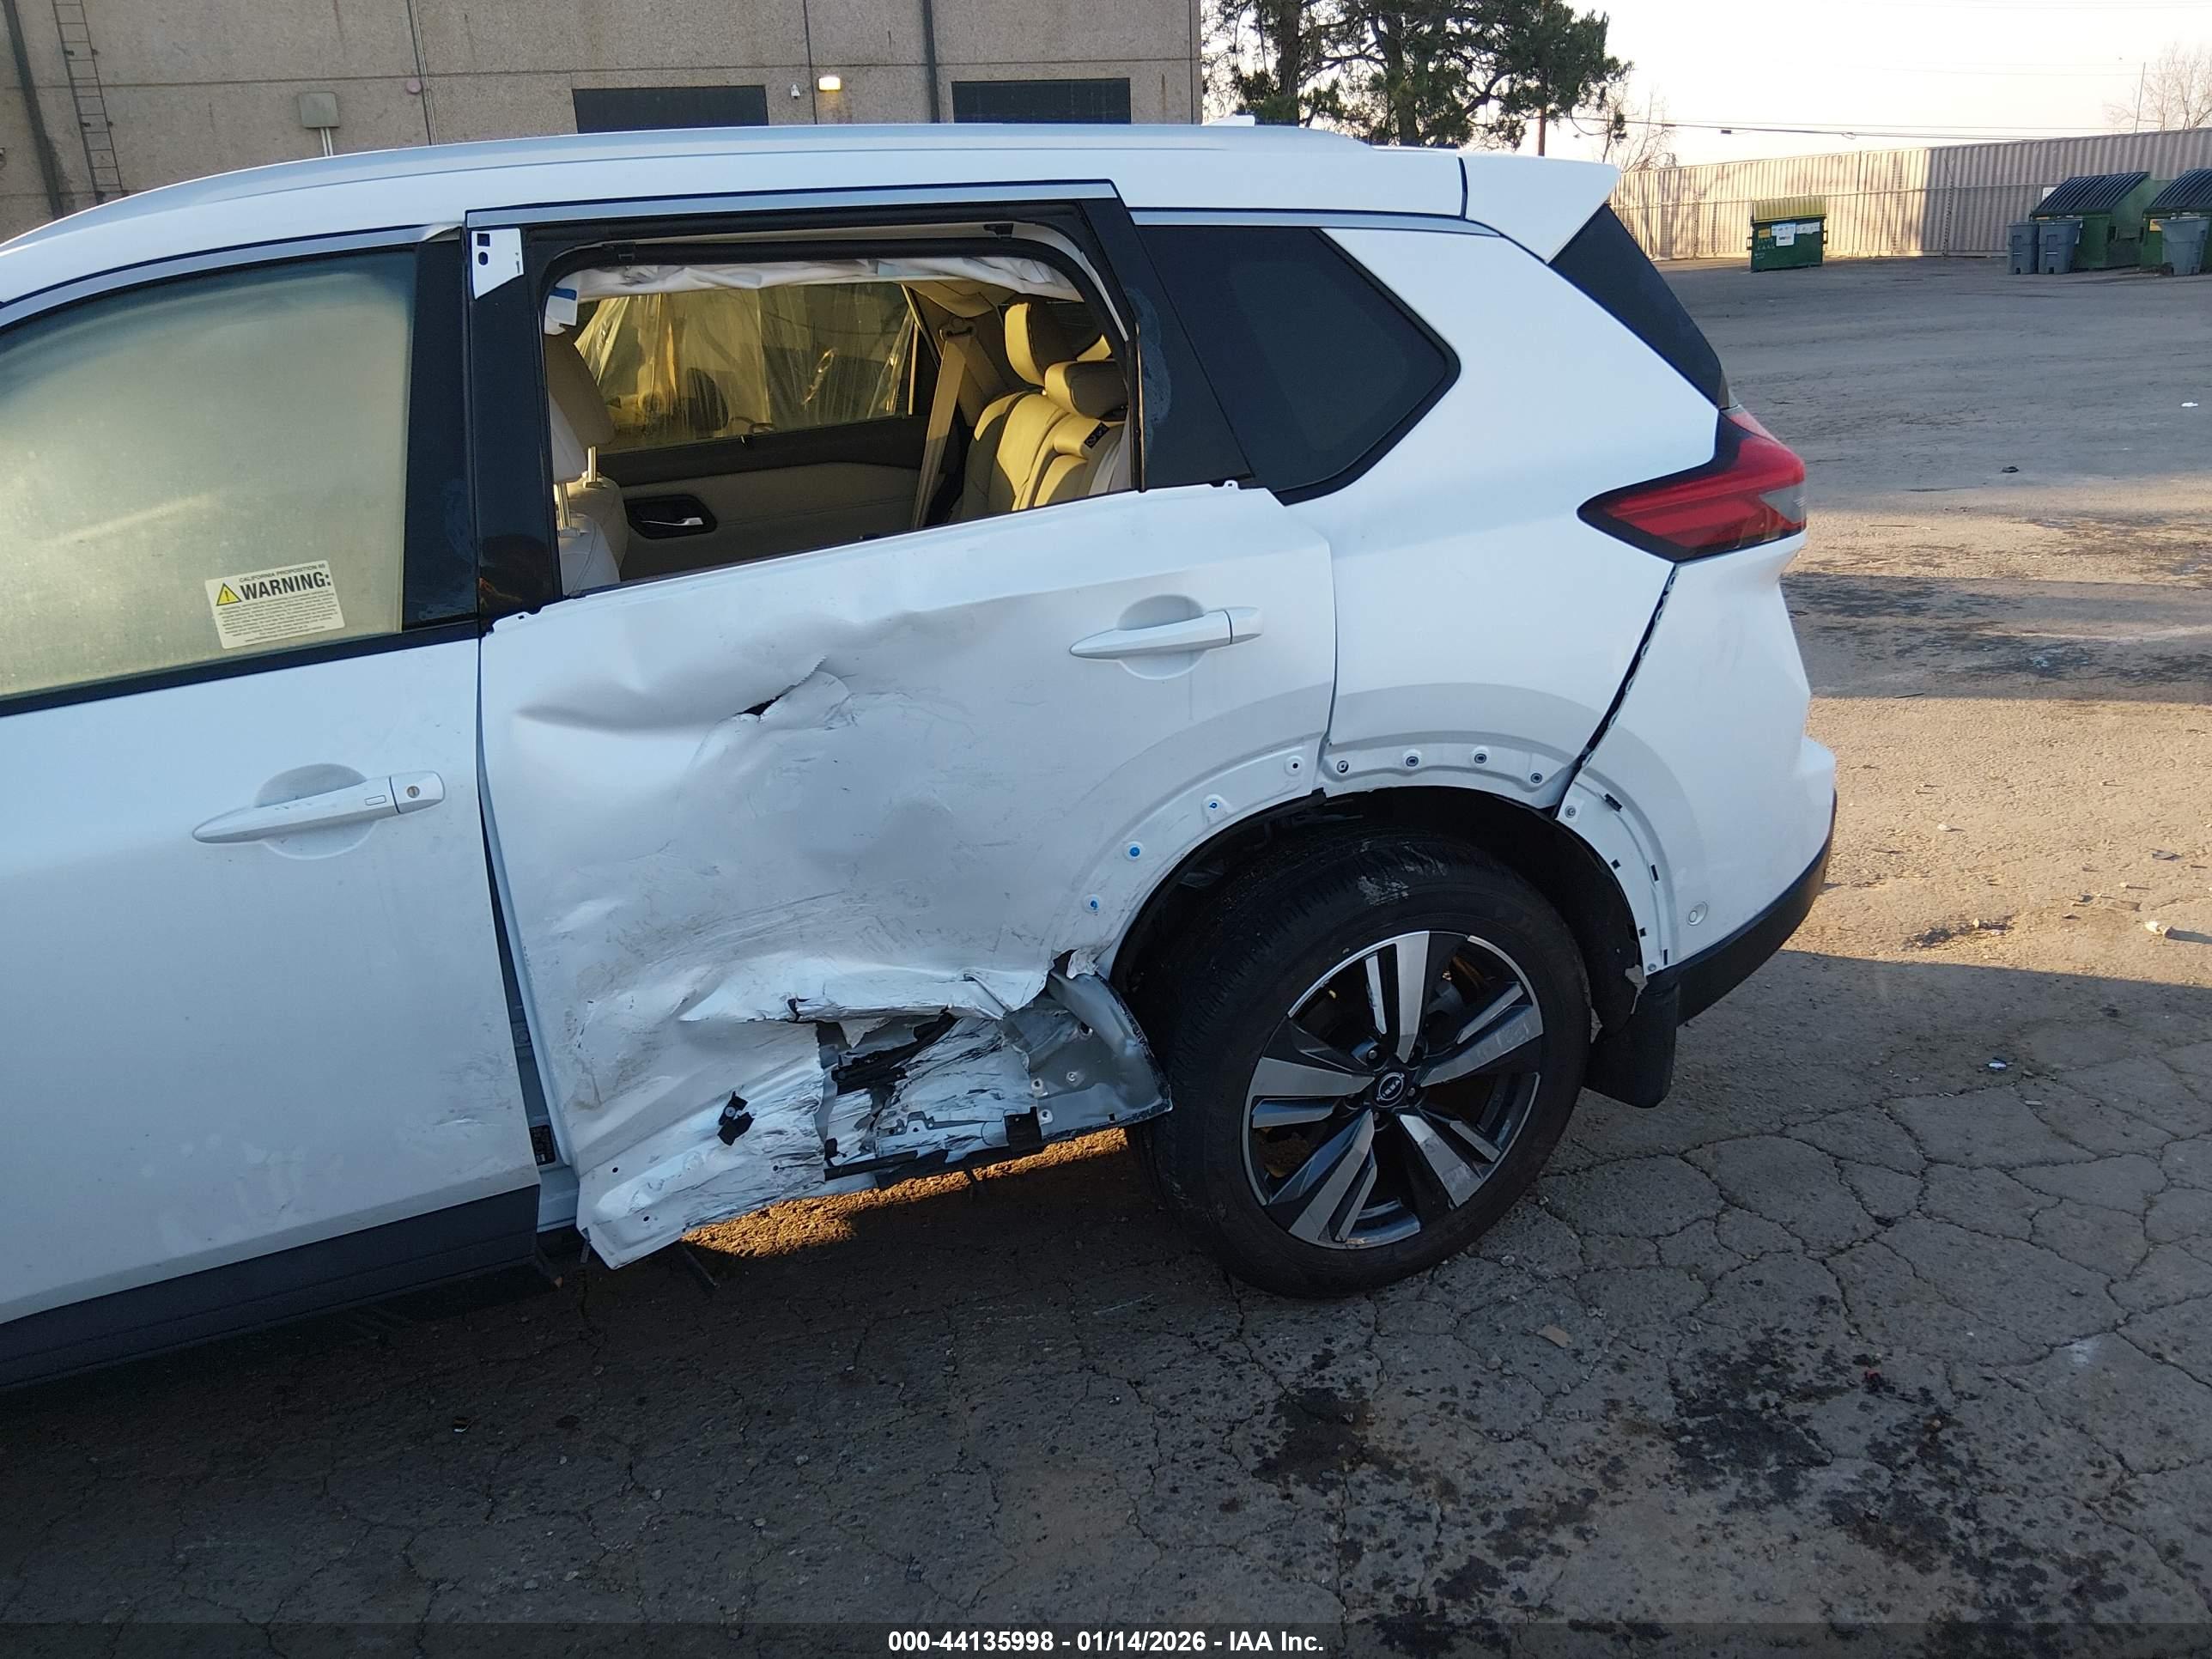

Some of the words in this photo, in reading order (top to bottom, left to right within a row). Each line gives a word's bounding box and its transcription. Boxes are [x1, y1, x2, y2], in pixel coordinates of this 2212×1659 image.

[239, 573, 276, 582] CALIFORNIA
[276, 565, 318, 576] PROPOSITION
[240, 571, 332, 600] WARNING:
